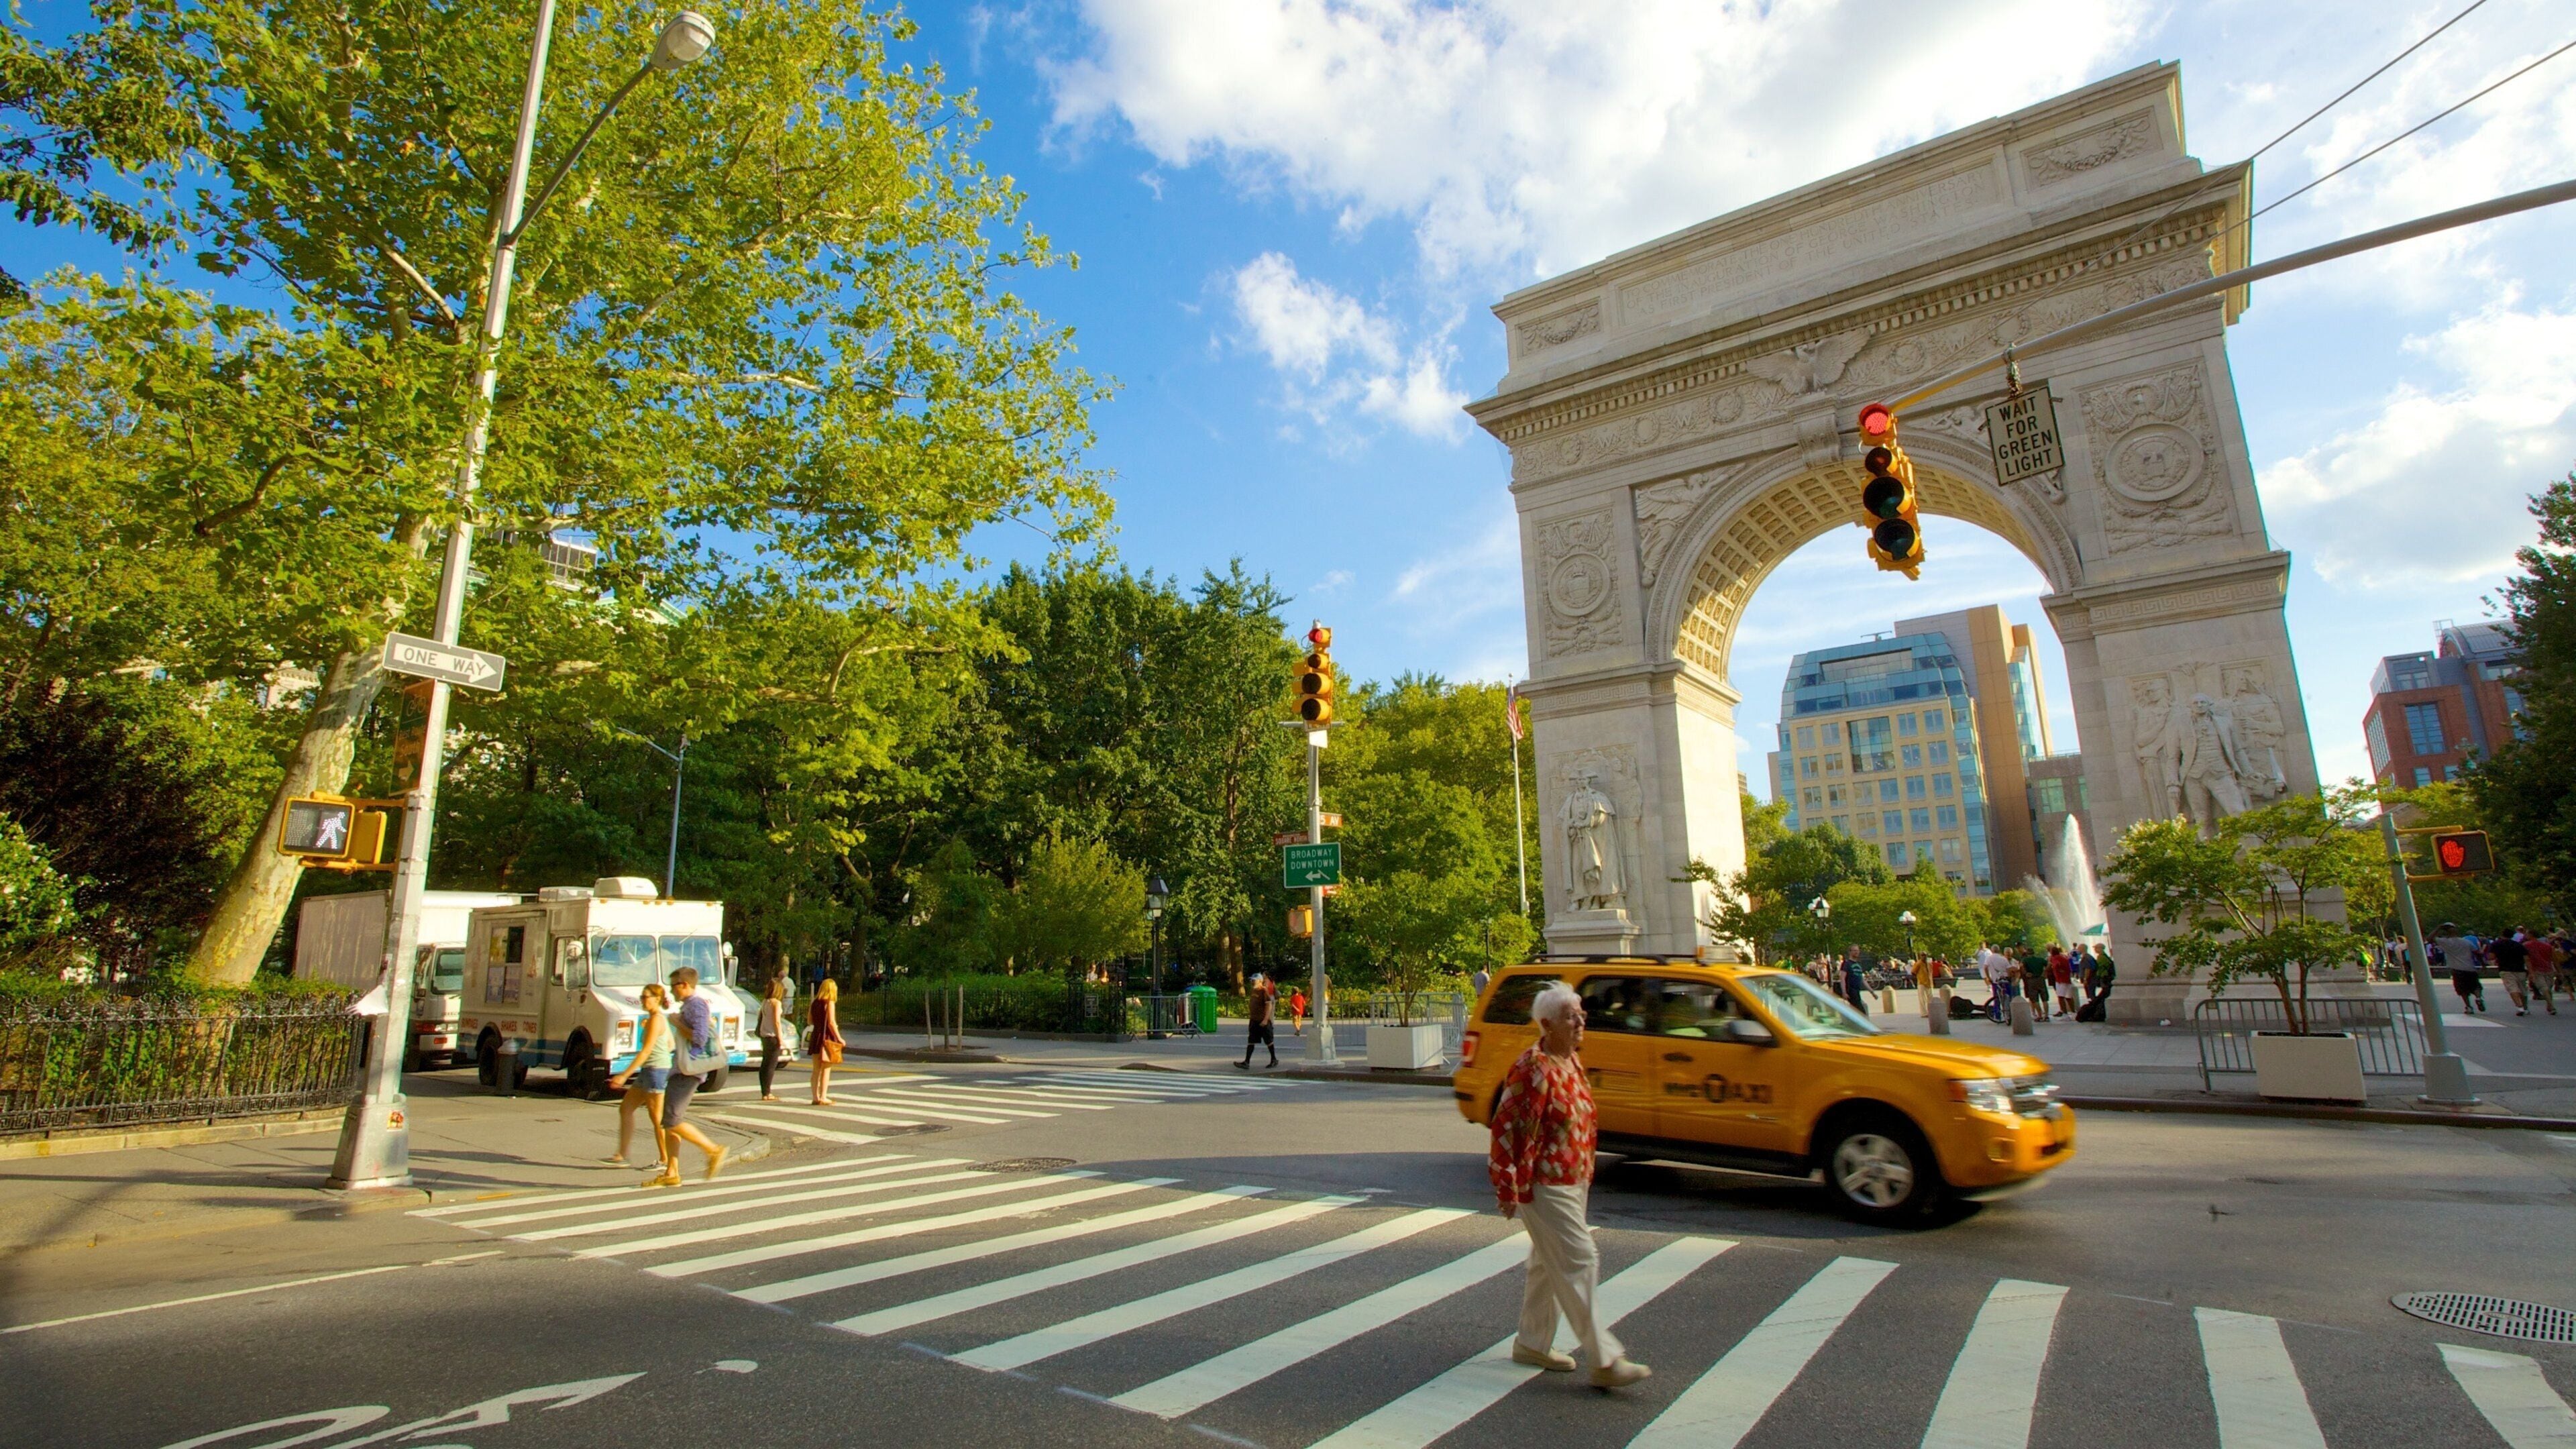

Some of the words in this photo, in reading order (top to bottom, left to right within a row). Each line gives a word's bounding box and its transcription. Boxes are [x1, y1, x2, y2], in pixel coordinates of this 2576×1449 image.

[1625, 286, 1640, 299] TO
[1642, 254, 1739, 294] COMMEMORATE
[1742, 243, 1768, 260] THE
[1770, 234, 1797, 250] ONE
[1800, 203, 1882, 241] HUNDREDTH
[1888, 170, 1984, 210] ANNIVERSARY
[1627, 297, 1642, 309] OF
[1648, 288, 1672, 303] THE
[1677, 251, 1778, 293] INAUGURATION
[1784, 243, 1803, 257] OF
[1809, 221, 1866, 249] GEORGE
[1874, 182, 1985, 227] WASHINGTON
[1640, 306, 1654, 316] AS
[1660, 290, 1696, 309] FIRST
[1700, 266, 1772, 297] PRESIDENT
[1778, 256, 1798, 270] OF
[1806, 244, 1836, 261] THE
[1843, 222, 1900, 250] UNITED
[1999, 396, 2036, 422] WAIT
[2006, 416, 2038, 439] FOR
[1999, 429, 2053, 460] GREEN
[2005, 449, 2052, 477] LIGHT
[404, 648, 438, 666] ONE
[453, 658, 486, 676] WAY
[1330, 817, 1339, 826] AV
[1291, 849, 1333, 859] BROADWAY
[1291, 859, 1334, 870] DOWNTOWN
